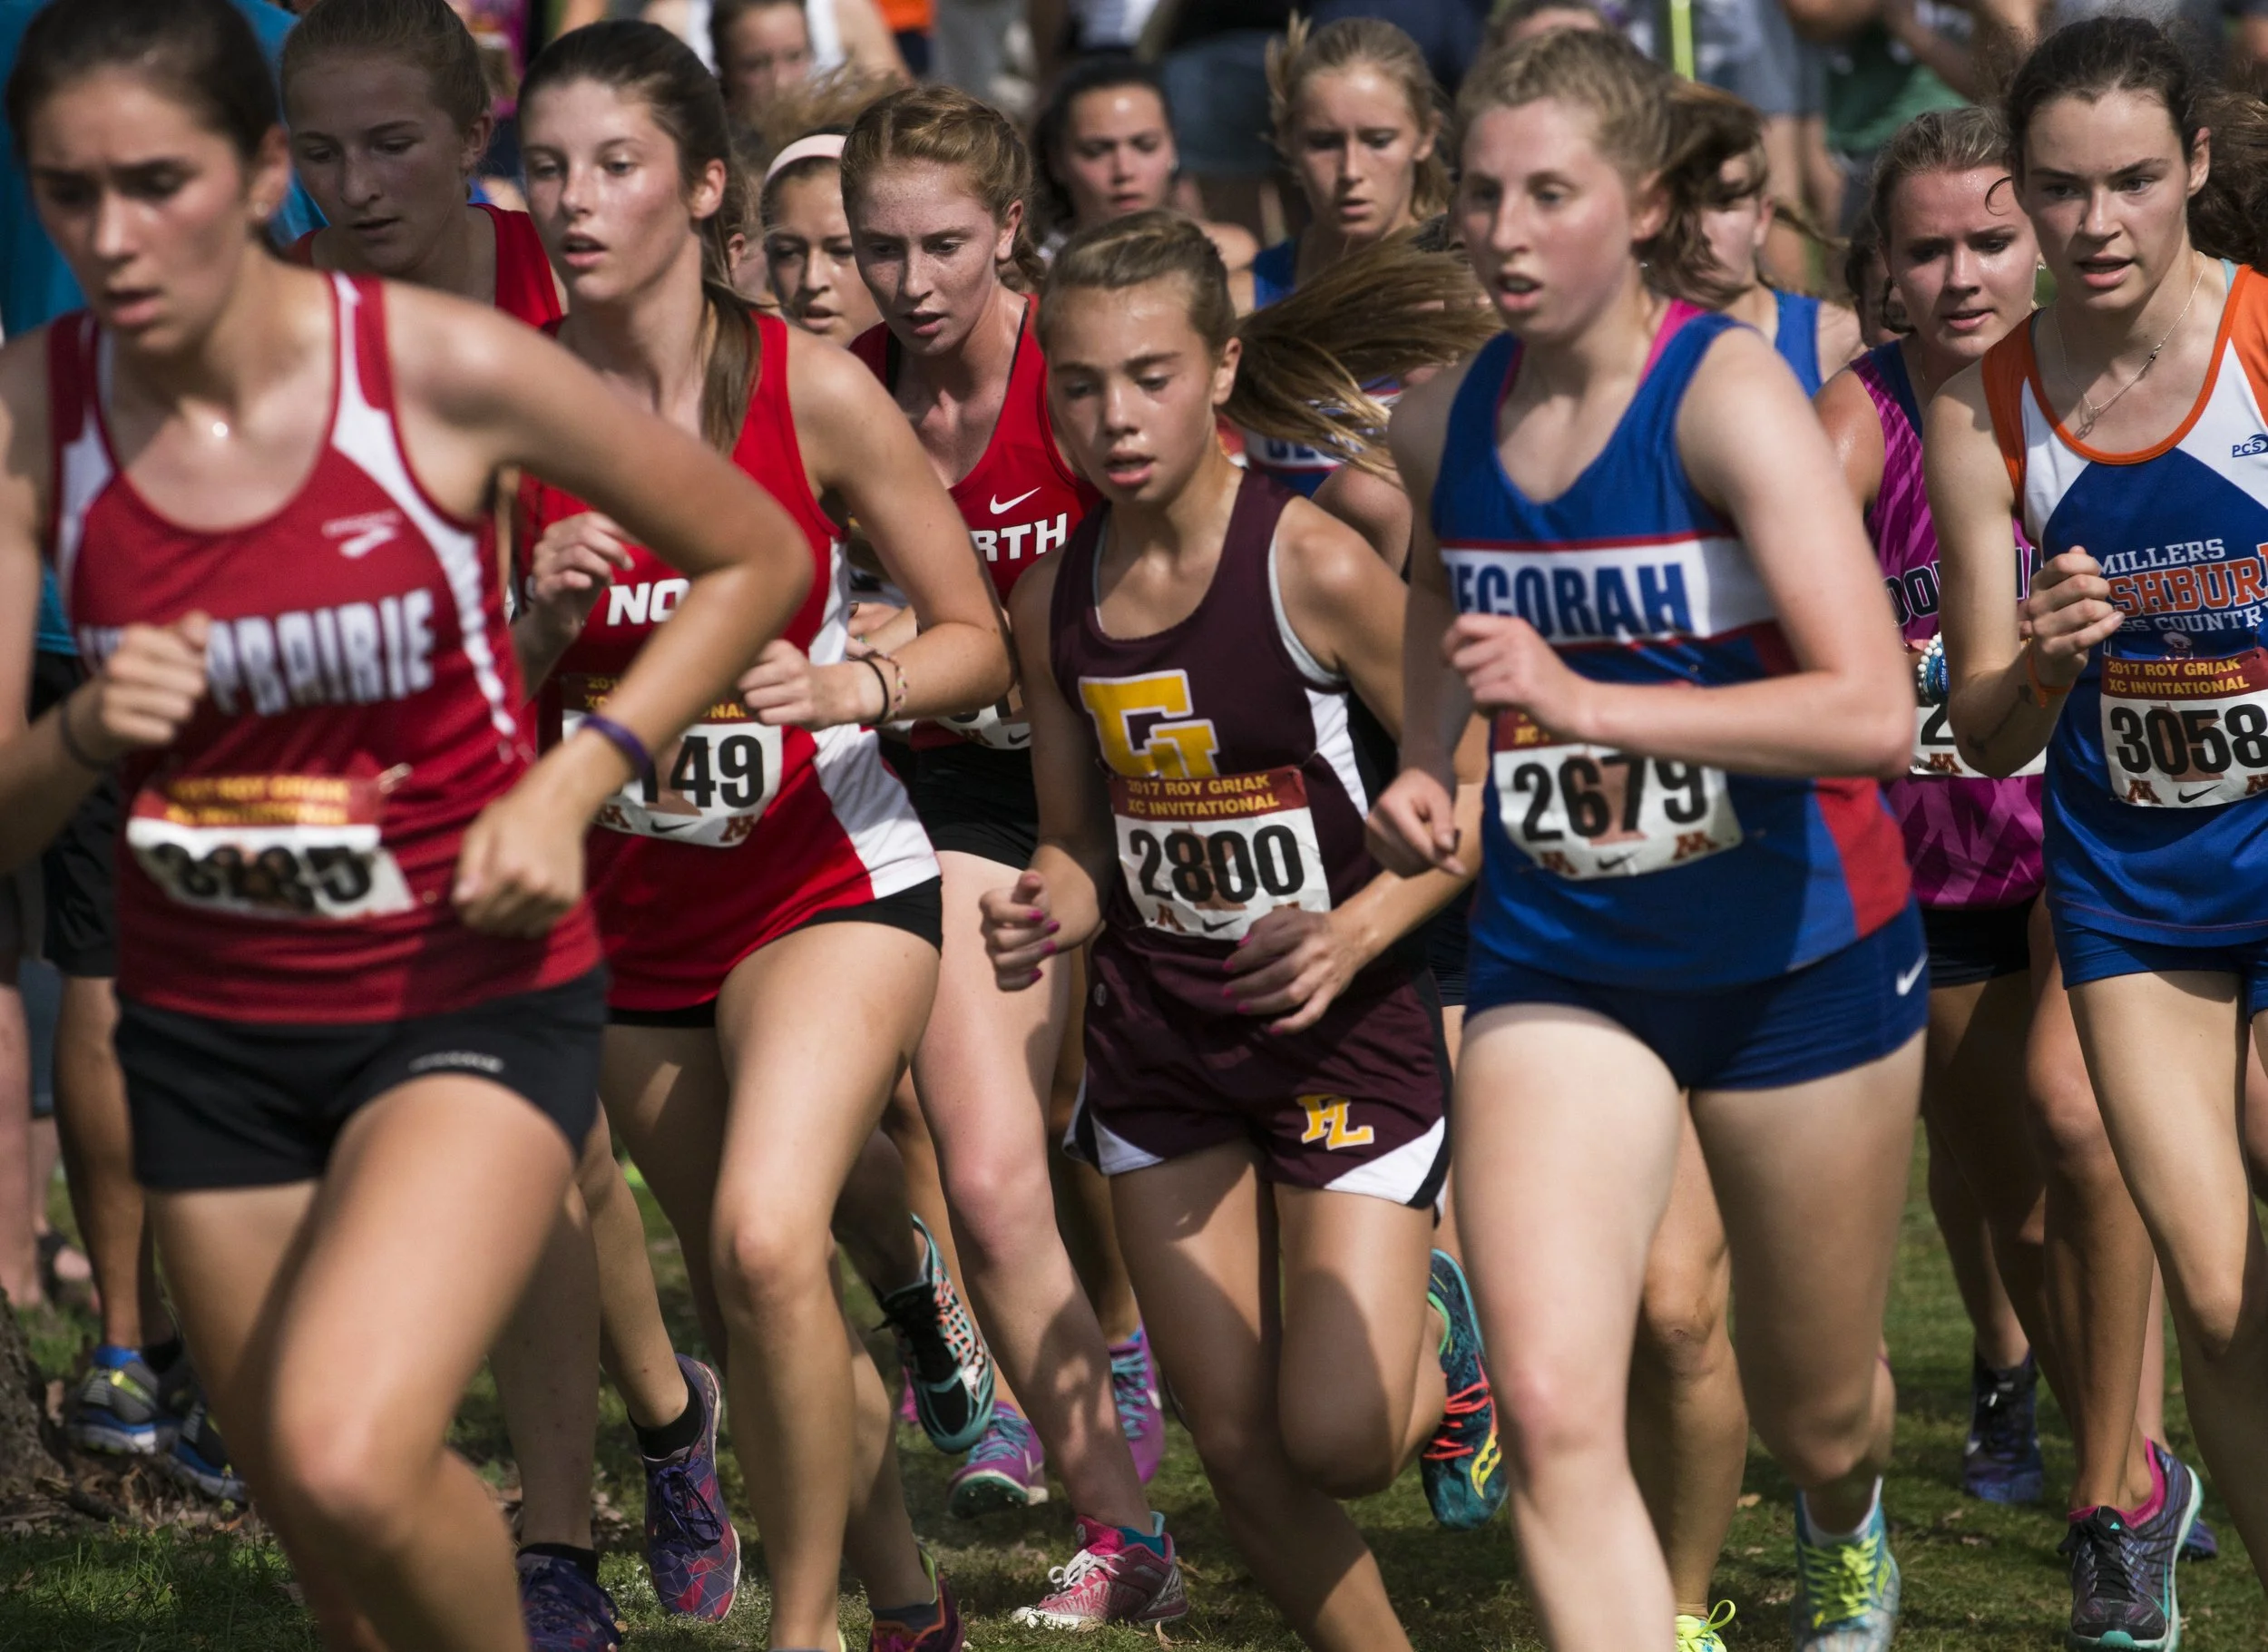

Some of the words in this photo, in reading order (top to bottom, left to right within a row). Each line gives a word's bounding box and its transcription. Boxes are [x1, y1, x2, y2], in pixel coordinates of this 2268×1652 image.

[969, 513, 1067, 562] RTH
[2101, 538, 2225, 575] MILLERS
[1446, 562, 1694, 637] ECORAH
[2108, 543, 2268, 618] SHBUR
[2154, 602, 2268, 632] COUNTR
[2108, 660, 2140, 676] 2017
[2145, 663, 2179, 677] ROY
[2184, 658, 2242, 677] GRIAK
[2108, 678, 2126, 692] XC
[2131, 675, 2250, 695] INVITATIONAL
[2110, 703, 2268, 777] 3058
[1127, 779, 1160, 796] 2017
[1164, 780, 1202, 797] ROY
[1208, 773, 1271, 795] GRIAK
[1128, 798, 1146, 815] XC
[1149, 793, 1280, 816] INVITATIONAL
[1513, 752, 1708, 842] 2679
[1129, 825, 1305, 904] 2800
